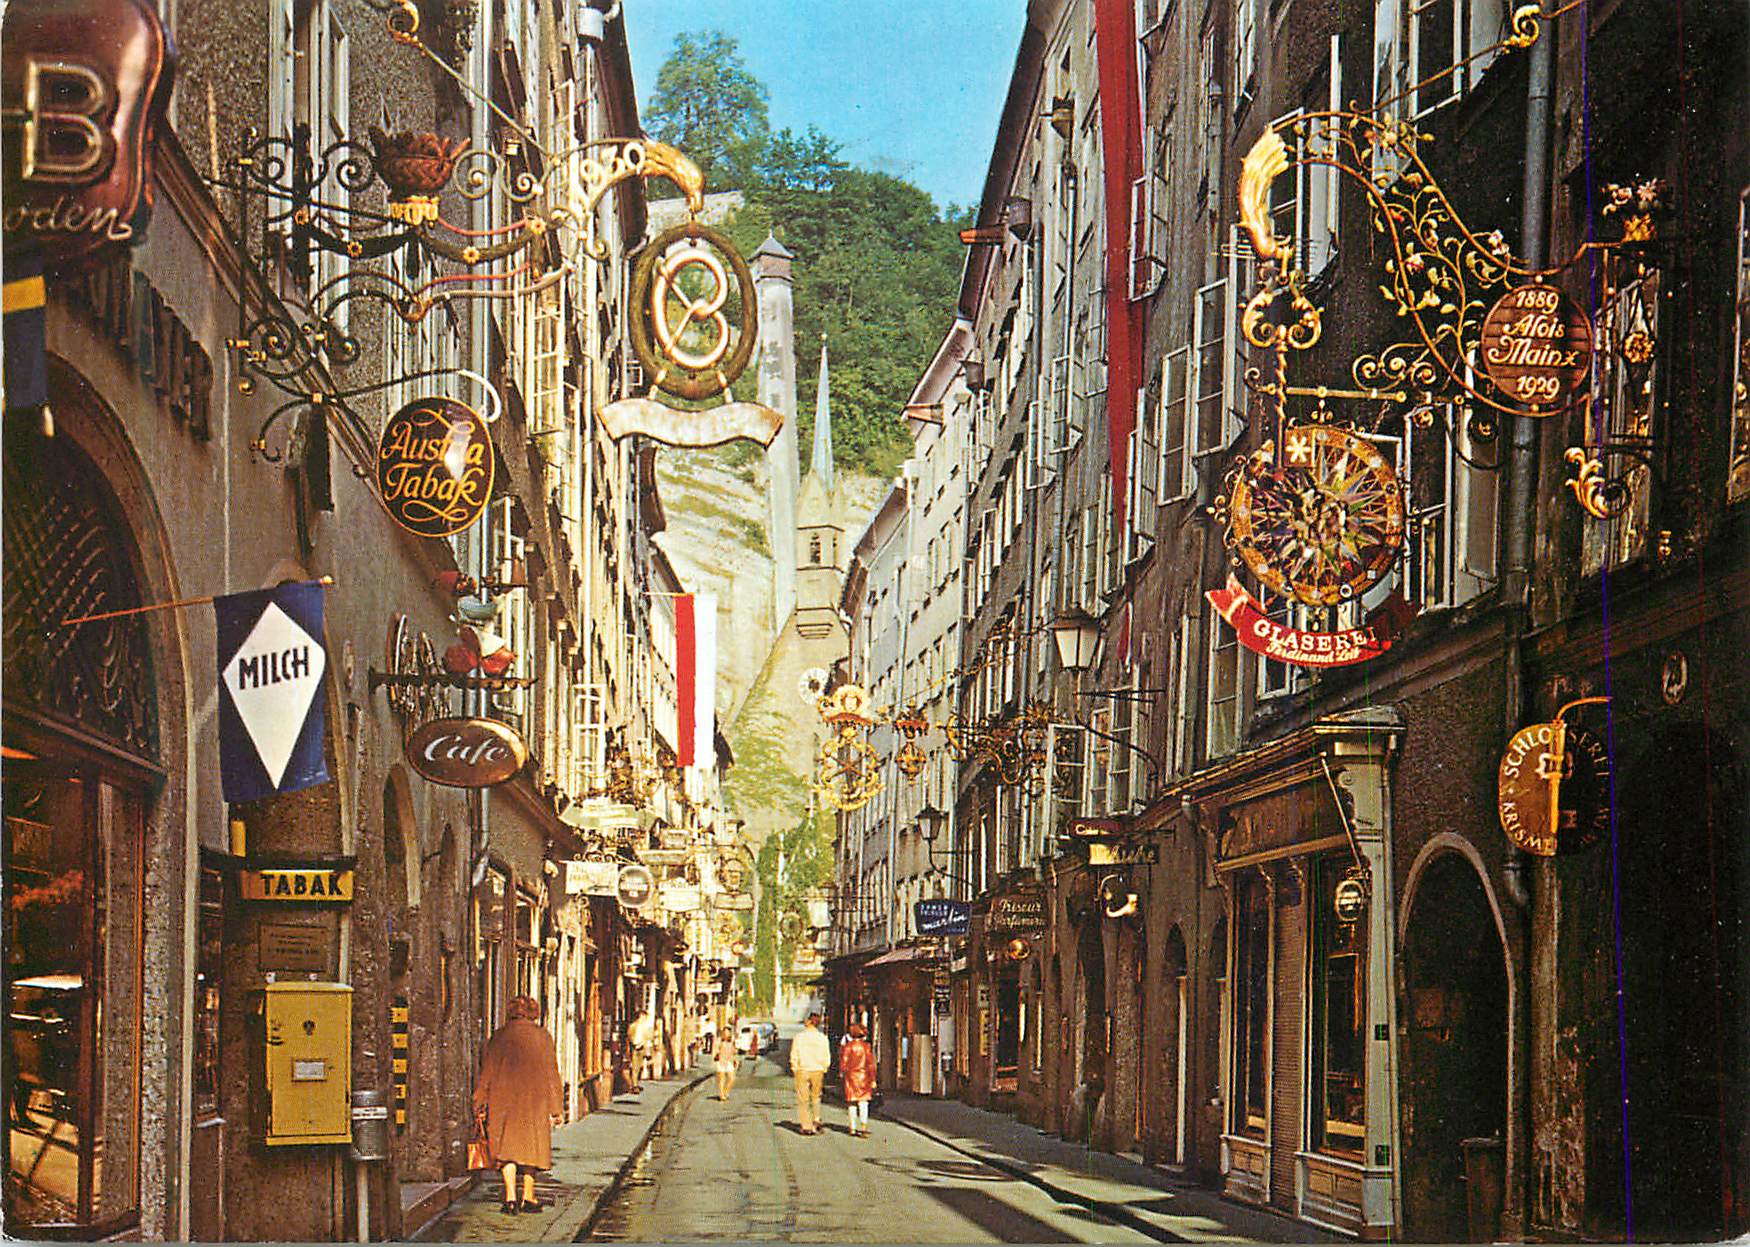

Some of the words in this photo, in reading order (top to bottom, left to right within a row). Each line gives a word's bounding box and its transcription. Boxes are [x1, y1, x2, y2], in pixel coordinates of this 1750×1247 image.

[1515, 289, 1560, 315] 1889
[1502, 313, 1566, 339] Alois
[1515, 374, 1561, 400] 1929
[381, 419, 485, 465] Austa
[384, 462, 486, 508] Tabak
[1253, 618, 1377, 652] GLASEREI
[1265, 641, 1335, 663] Ferdinand
[238, 645, 309, 690] MILCH
[259, 874, 342, 896] TABAK
